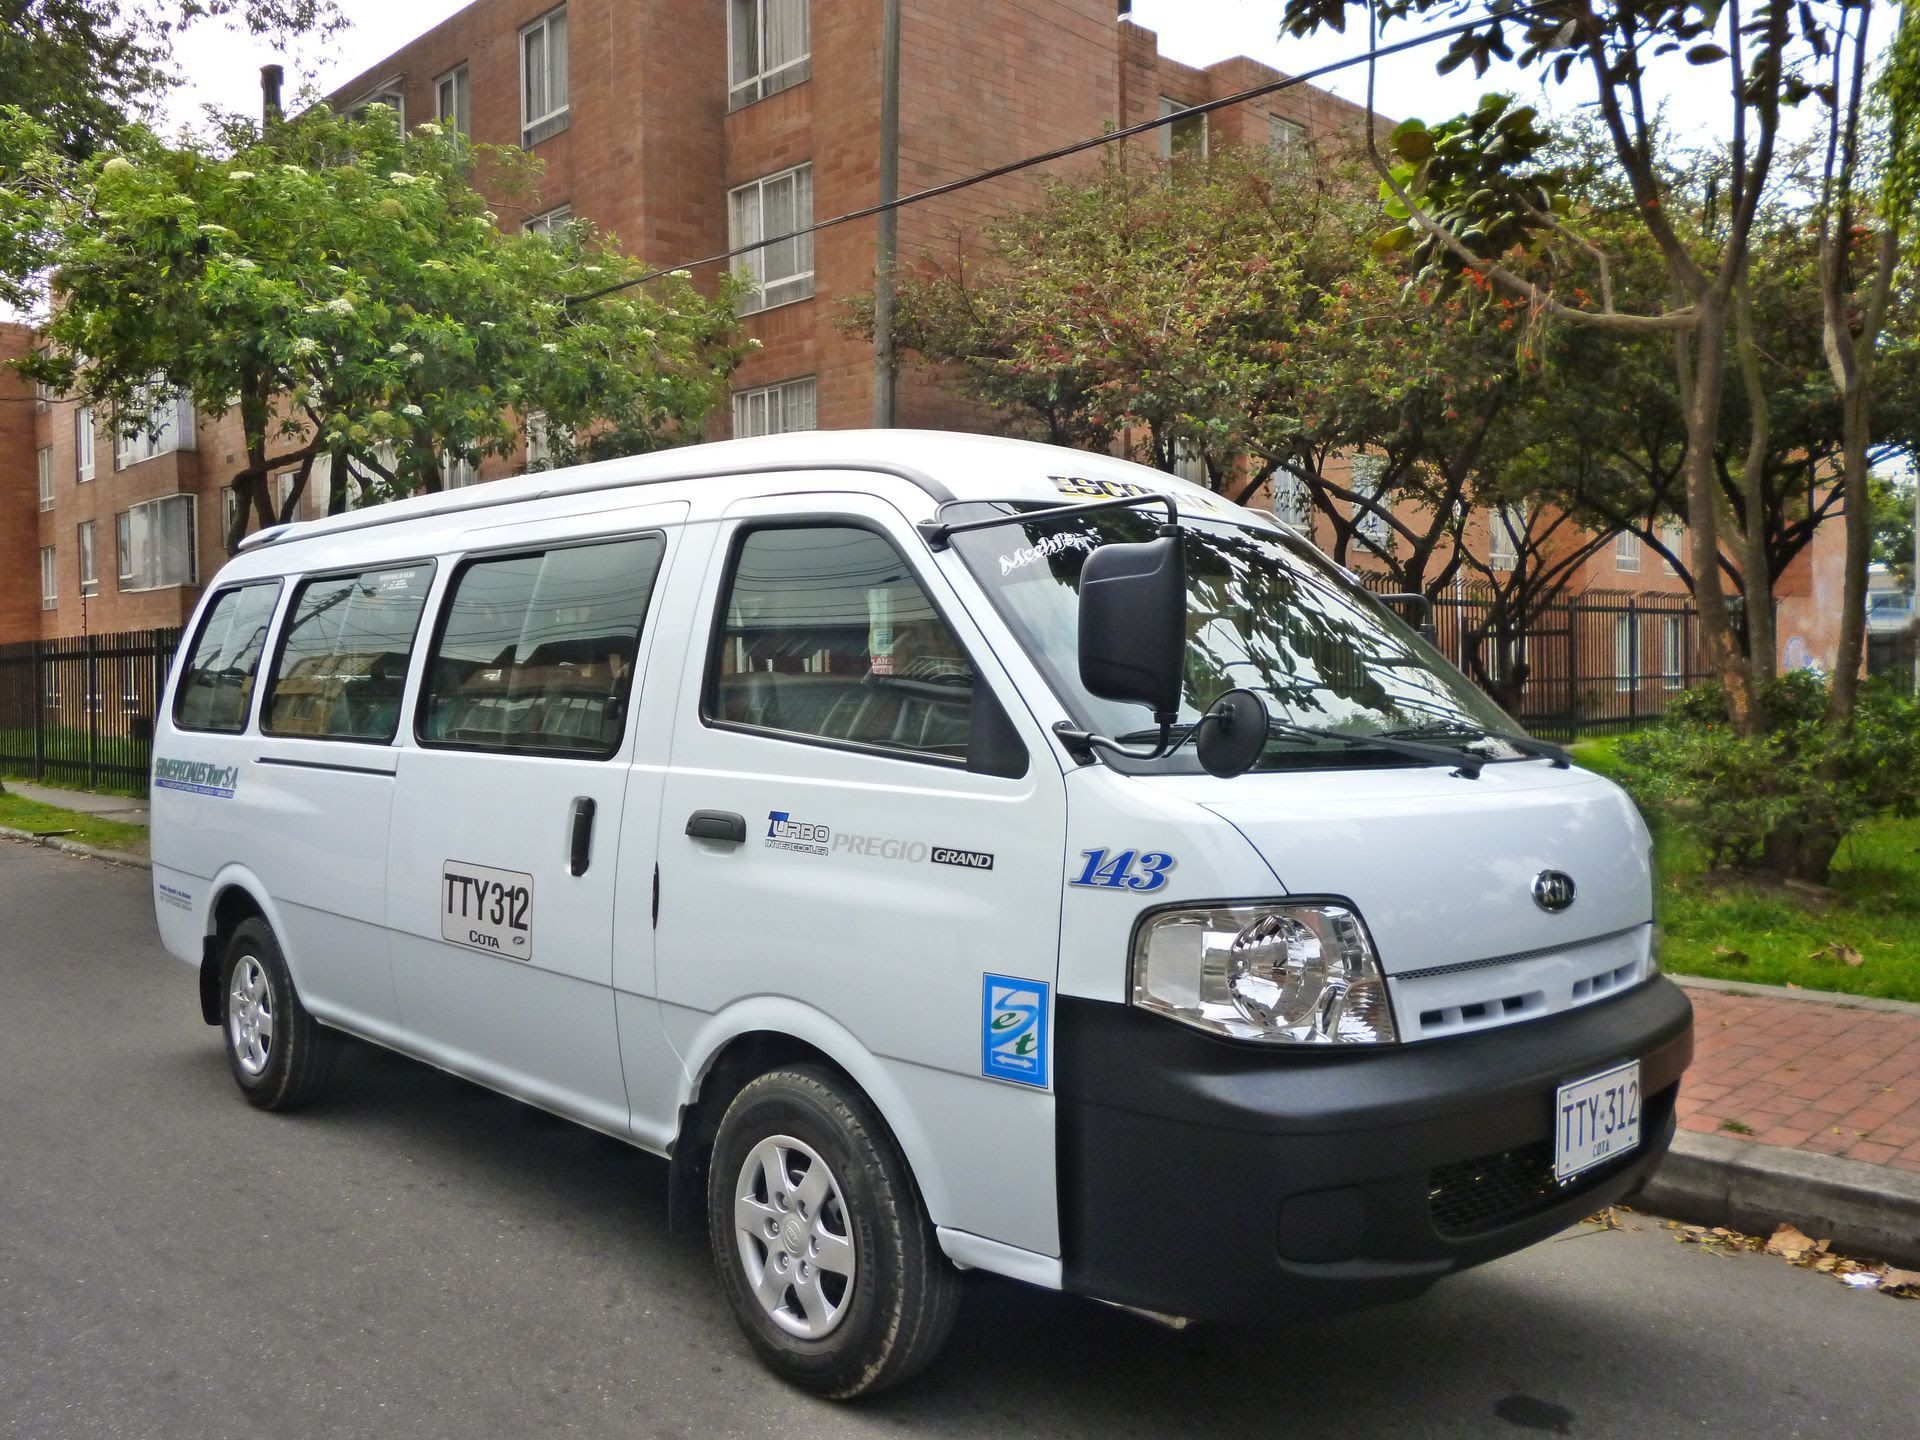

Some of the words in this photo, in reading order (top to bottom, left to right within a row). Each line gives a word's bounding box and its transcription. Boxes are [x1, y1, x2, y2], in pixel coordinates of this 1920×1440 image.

[767, 810, 830, 843] TURBO
[765, 839, 829, 856] INTERCOOLER
[832, 832, 928, 863] PREGIO
[932, 848, 993, 869] GRAND
[1069, 848, 1175, 893] 143
[444, 872, 530, 932] TTY312
[469, 930, 500, 949] COTA
[1592, 1139, 1610, 1158] COTA
